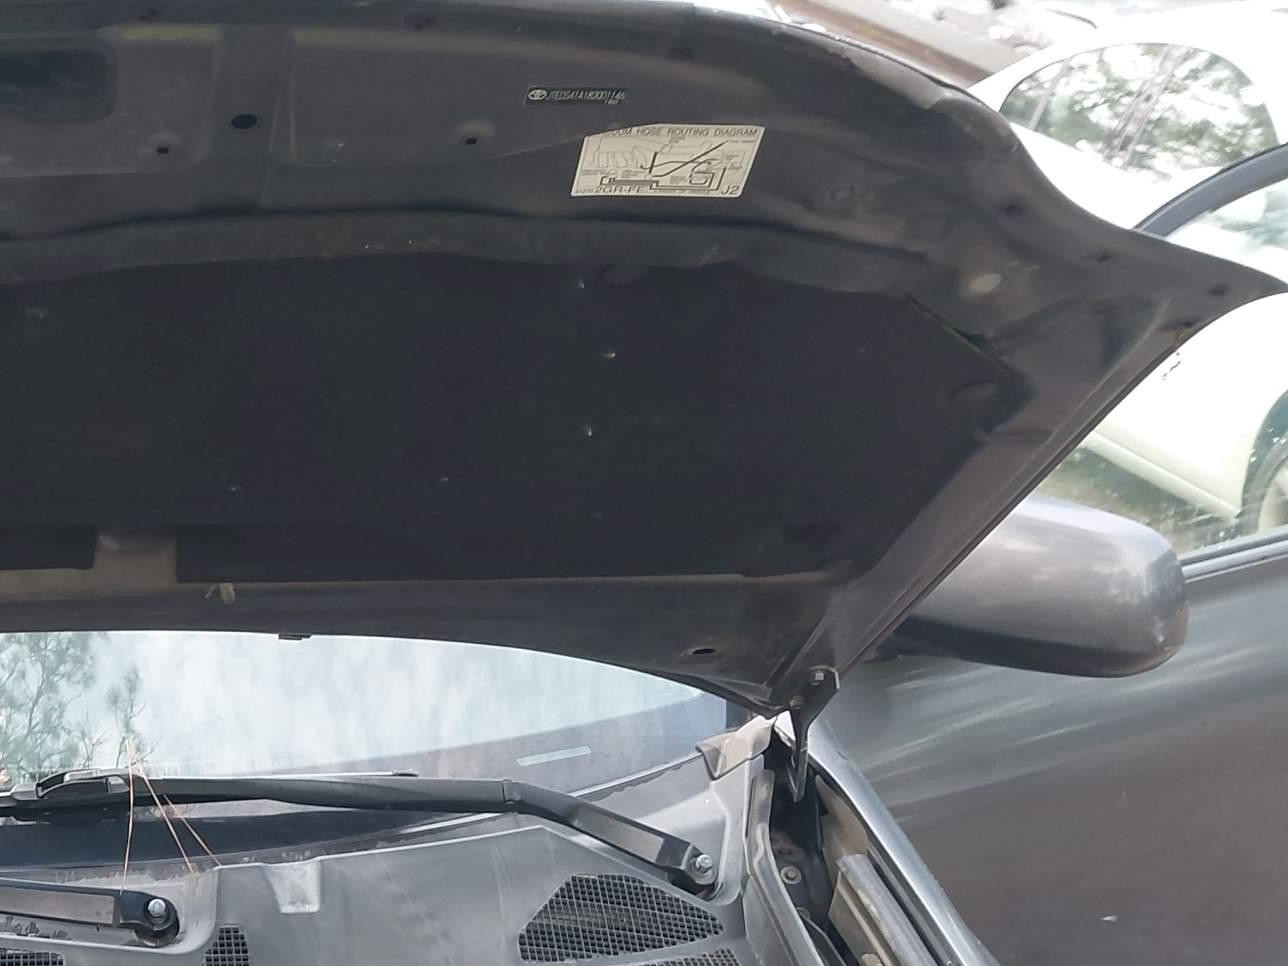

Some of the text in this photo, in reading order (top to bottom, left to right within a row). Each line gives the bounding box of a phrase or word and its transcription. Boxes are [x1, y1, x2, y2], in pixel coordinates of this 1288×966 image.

[636, 126, 662, 137] HOSE
[666, 126, 710, 137] ROUTING
[713, 127, 758, 137] DIAGRAM
